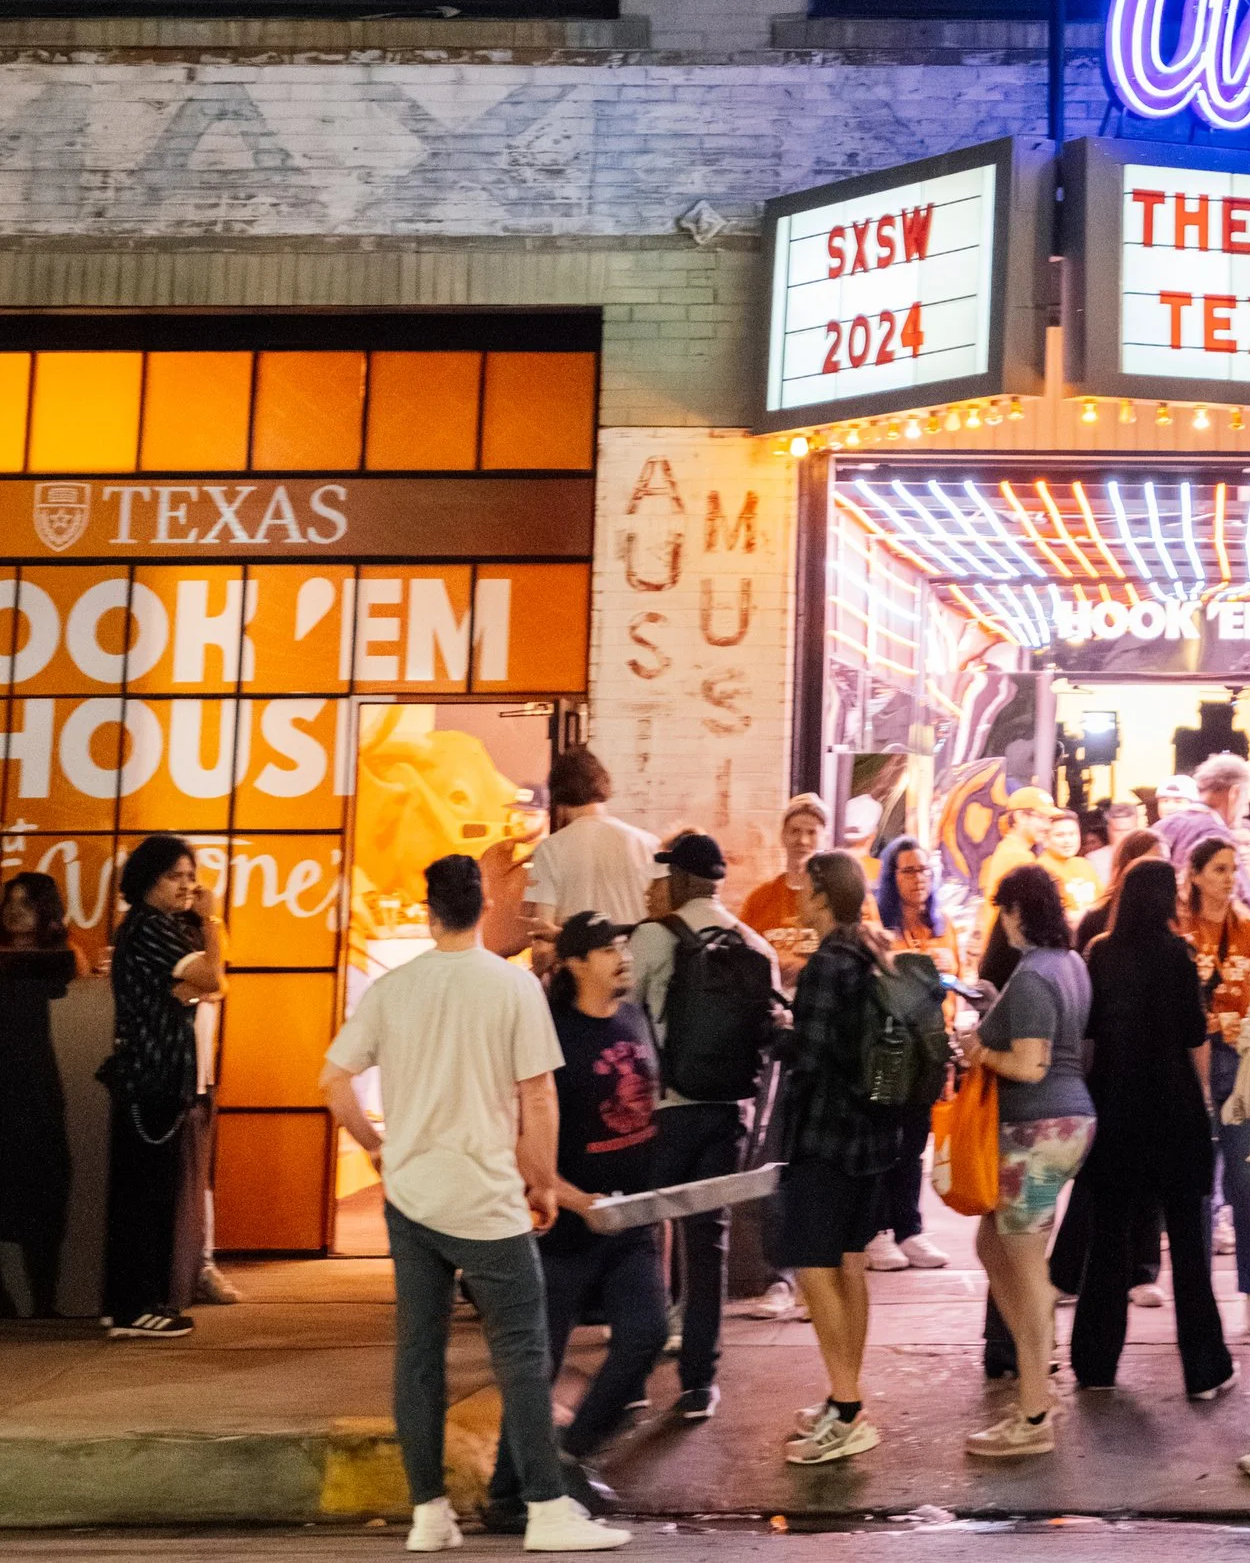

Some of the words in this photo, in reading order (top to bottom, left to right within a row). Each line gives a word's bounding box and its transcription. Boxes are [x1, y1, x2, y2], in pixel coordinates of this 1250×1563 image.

[827, 202, 935, 280] SXSW
[821, 301, 926, 375] 2024
[102, 484, 348, 545] TEXAS
[295, 577, 512, 681] 'EM
[620, 454, 686, 813] AUST
[700, 489, 761, 833] MUSI
[1061, 601, 1199, 640] HOOK
[0, 698, 354, 799] HOUS
